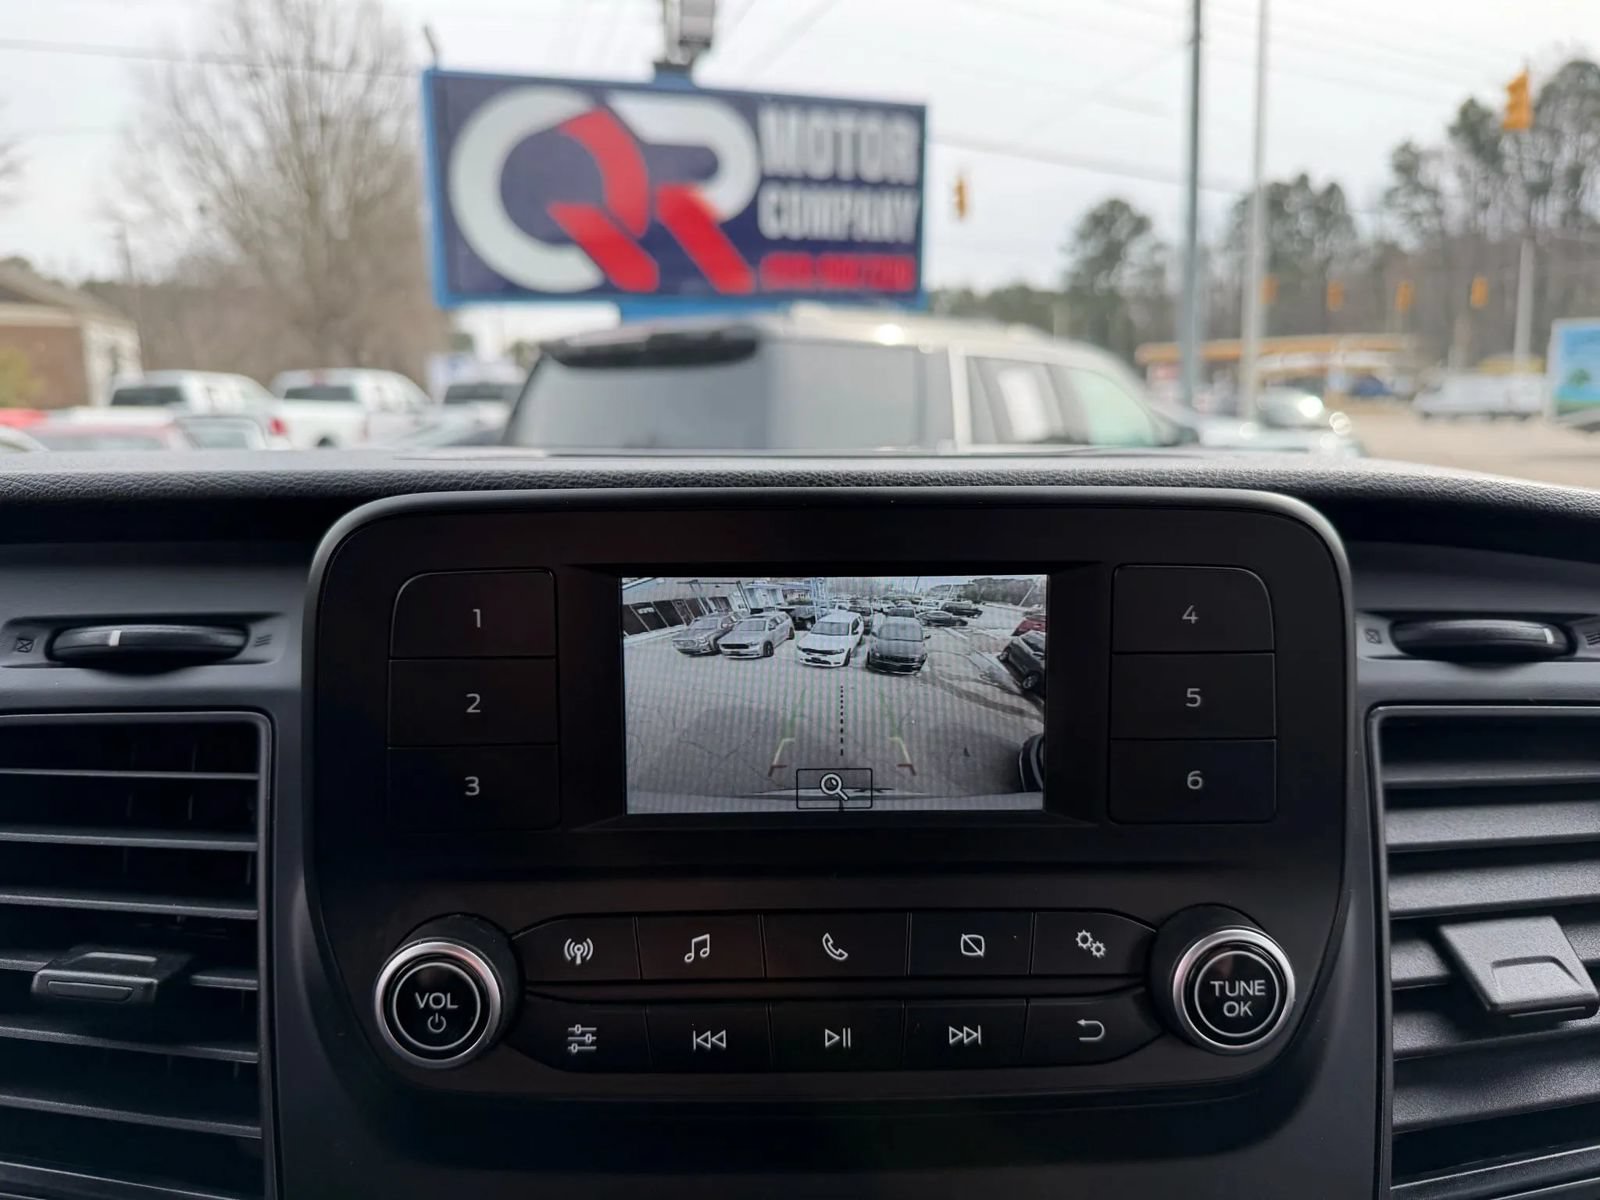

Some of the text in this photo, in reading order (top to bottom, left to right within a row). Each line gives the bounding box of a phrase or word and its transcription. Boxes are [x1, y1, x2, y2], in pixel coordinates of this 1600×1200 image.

[758, 105, 919, 184] MOTOR
[757, 182, 919, 243] COMPANY
[472, 608, 481, 628] 1
[1182, 605, 1198, 624] 4
[466, 693, 481, 713] 2
[1186, 687, 1201, 707] 5
[465, 776, 480, 796] 3
[1187, 770, 1203, 790] 6
[1210, 980, 1266, 997] TUNE
[415, 992, 459, 1009] VOL
[1223, 1001, 1253, 1018] OK
